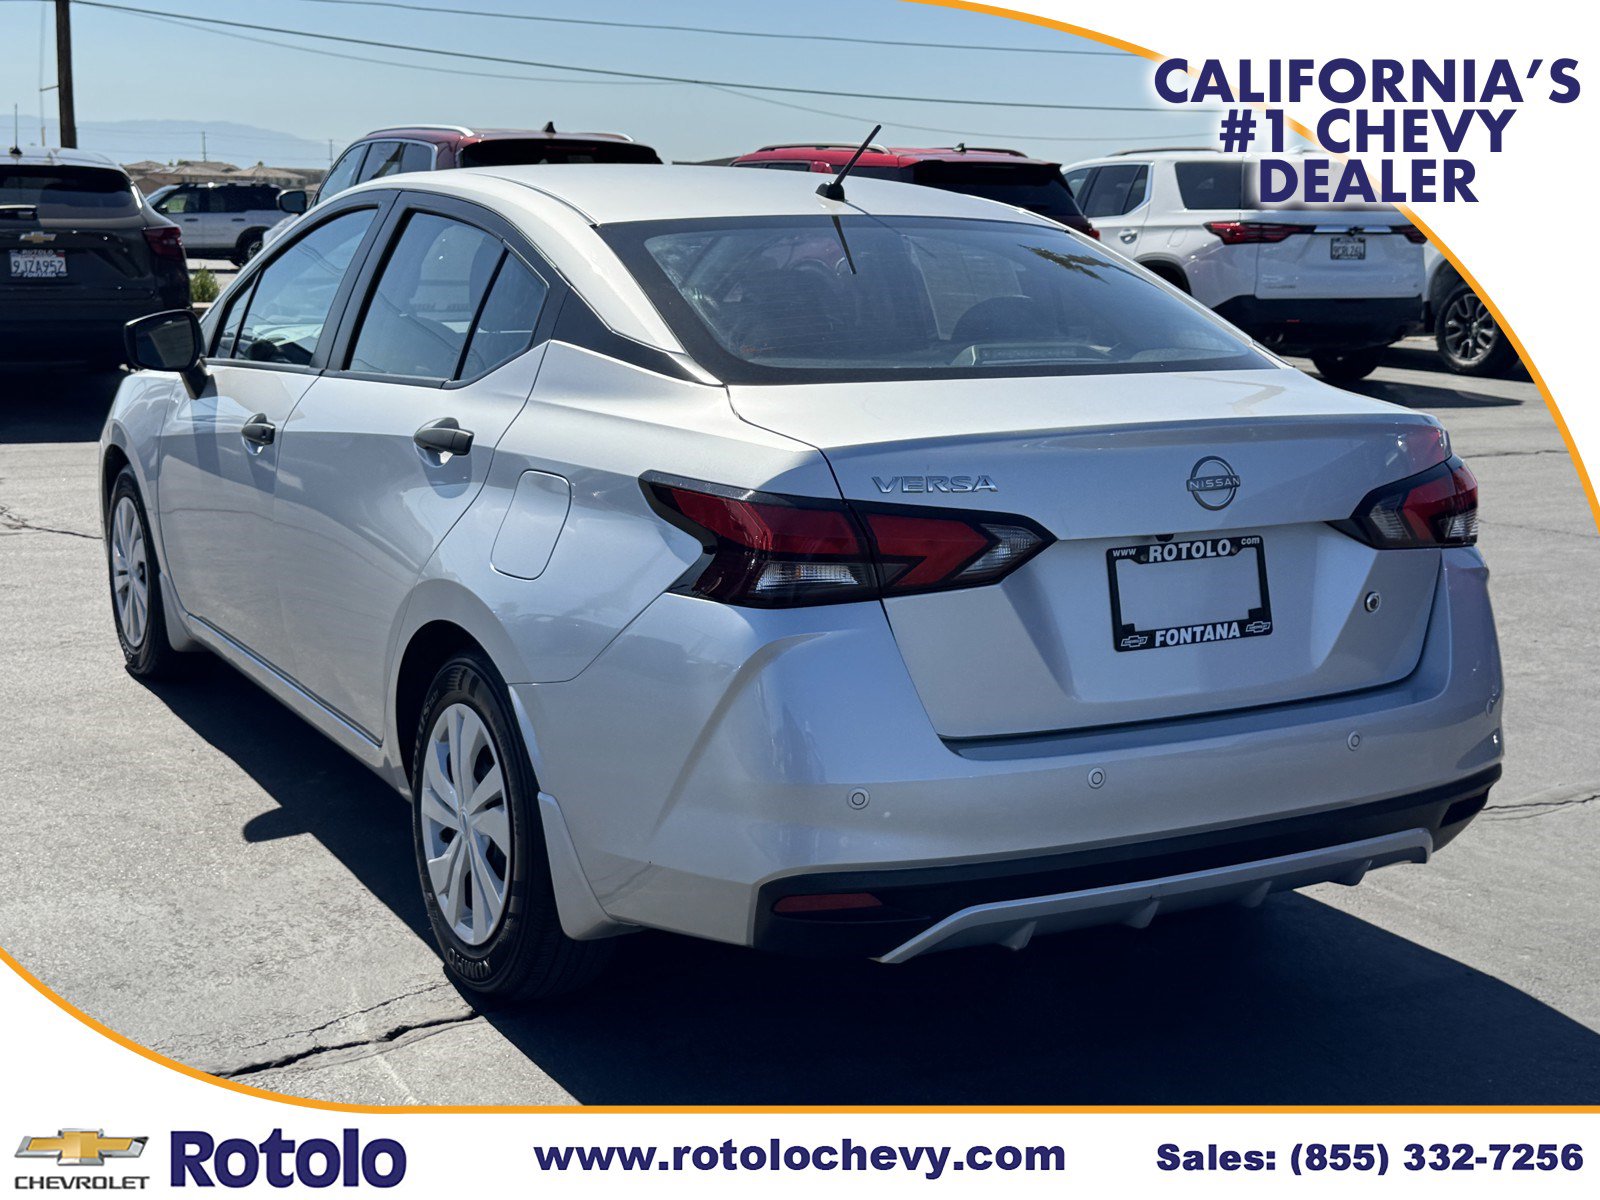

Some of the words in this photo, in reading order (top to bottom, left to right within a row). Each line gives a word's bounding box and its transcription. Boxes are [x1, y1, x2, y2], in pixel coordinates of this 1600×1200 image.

[872, 475, 998, 493] VERSA
[1190, 477, 1240, 489] NISSAN
[1148, 539, 1232, 563] ROTOLO
[1240, 536, 1260, 546] com
[1154, 622, 1241, 647] FONTANA
